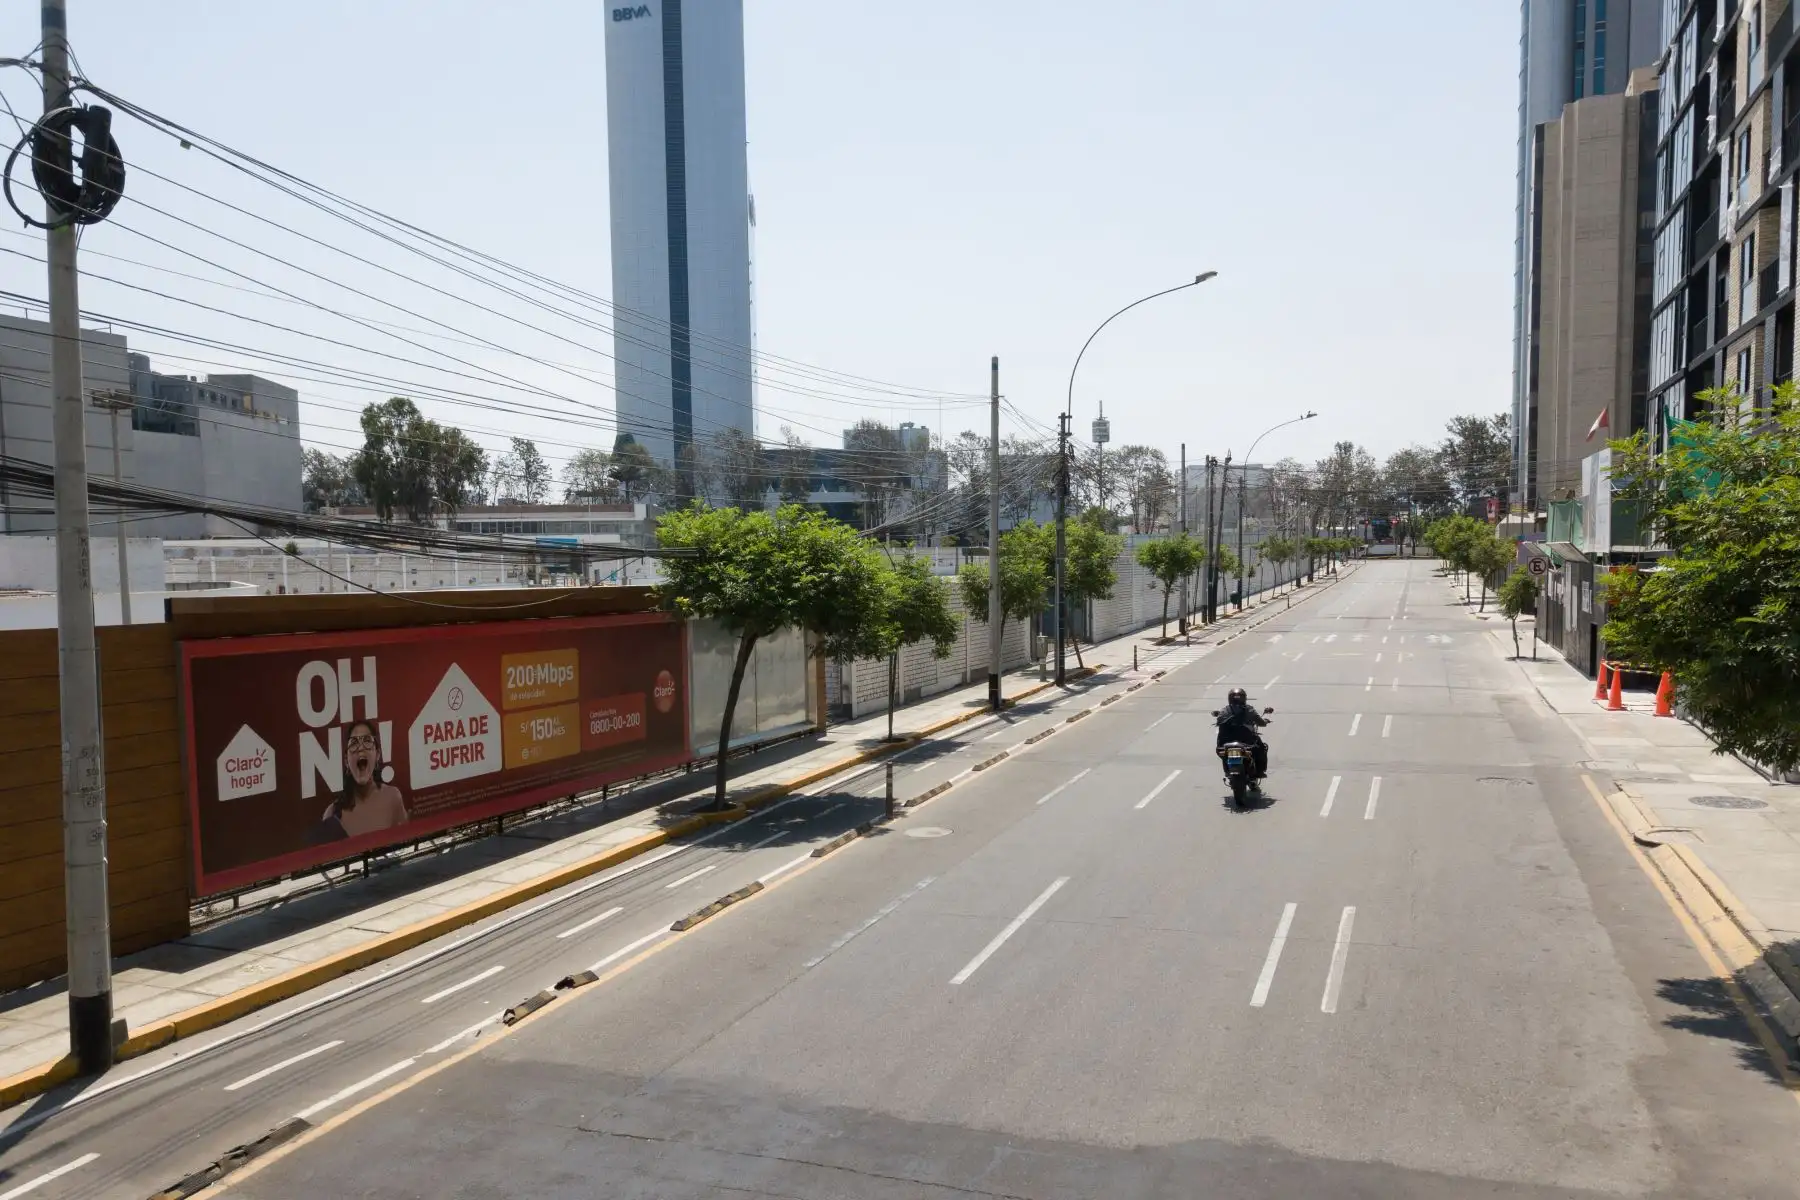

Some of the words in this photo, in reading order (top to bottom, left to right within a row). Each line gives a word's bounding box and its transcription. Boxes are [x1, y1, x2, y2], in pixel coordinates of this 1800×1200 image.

[613, 4, 652, 22] BBVA
[507, 665, 534, 689] 200
[536, 662, 574, 688] Mbps
[296, 656, 378, 728] OH
[654, 685, 672, 697] Claro
[423, 719, 466, 745] PARA
[469, 714, 489, 737] DE
[530, 718, 553, 741] 150
[590, 712, 640, 734] 0800-00-200
[225, 755, 264, 773] Claro
[430, 742, 486, 771] SUFRIR
[231, 773, 265, 789] hogar
